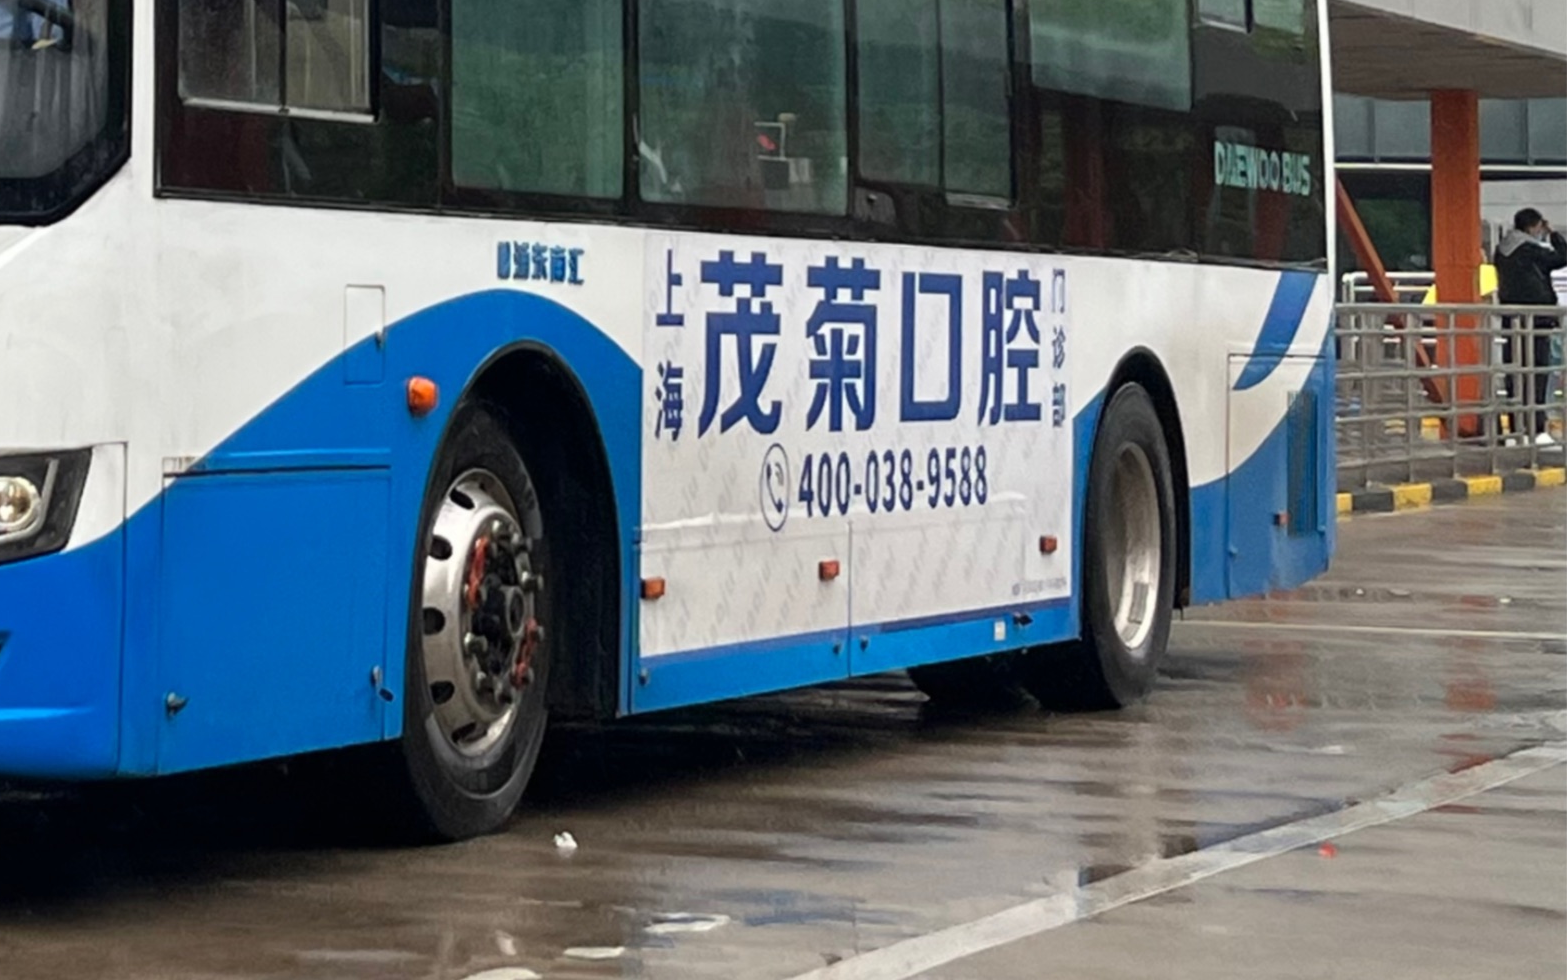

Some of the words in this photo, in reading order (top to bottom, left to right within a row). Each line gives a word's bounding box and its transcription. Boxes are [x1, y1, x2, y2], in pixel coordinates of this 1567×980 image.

[655, 249, 685, 441] 上海
[698, 250, 1042, 439] 茂菊口腔
[1051, 269, 1066, 428] 门诊部
[798, 445, 988, 518] 400-038-9588
